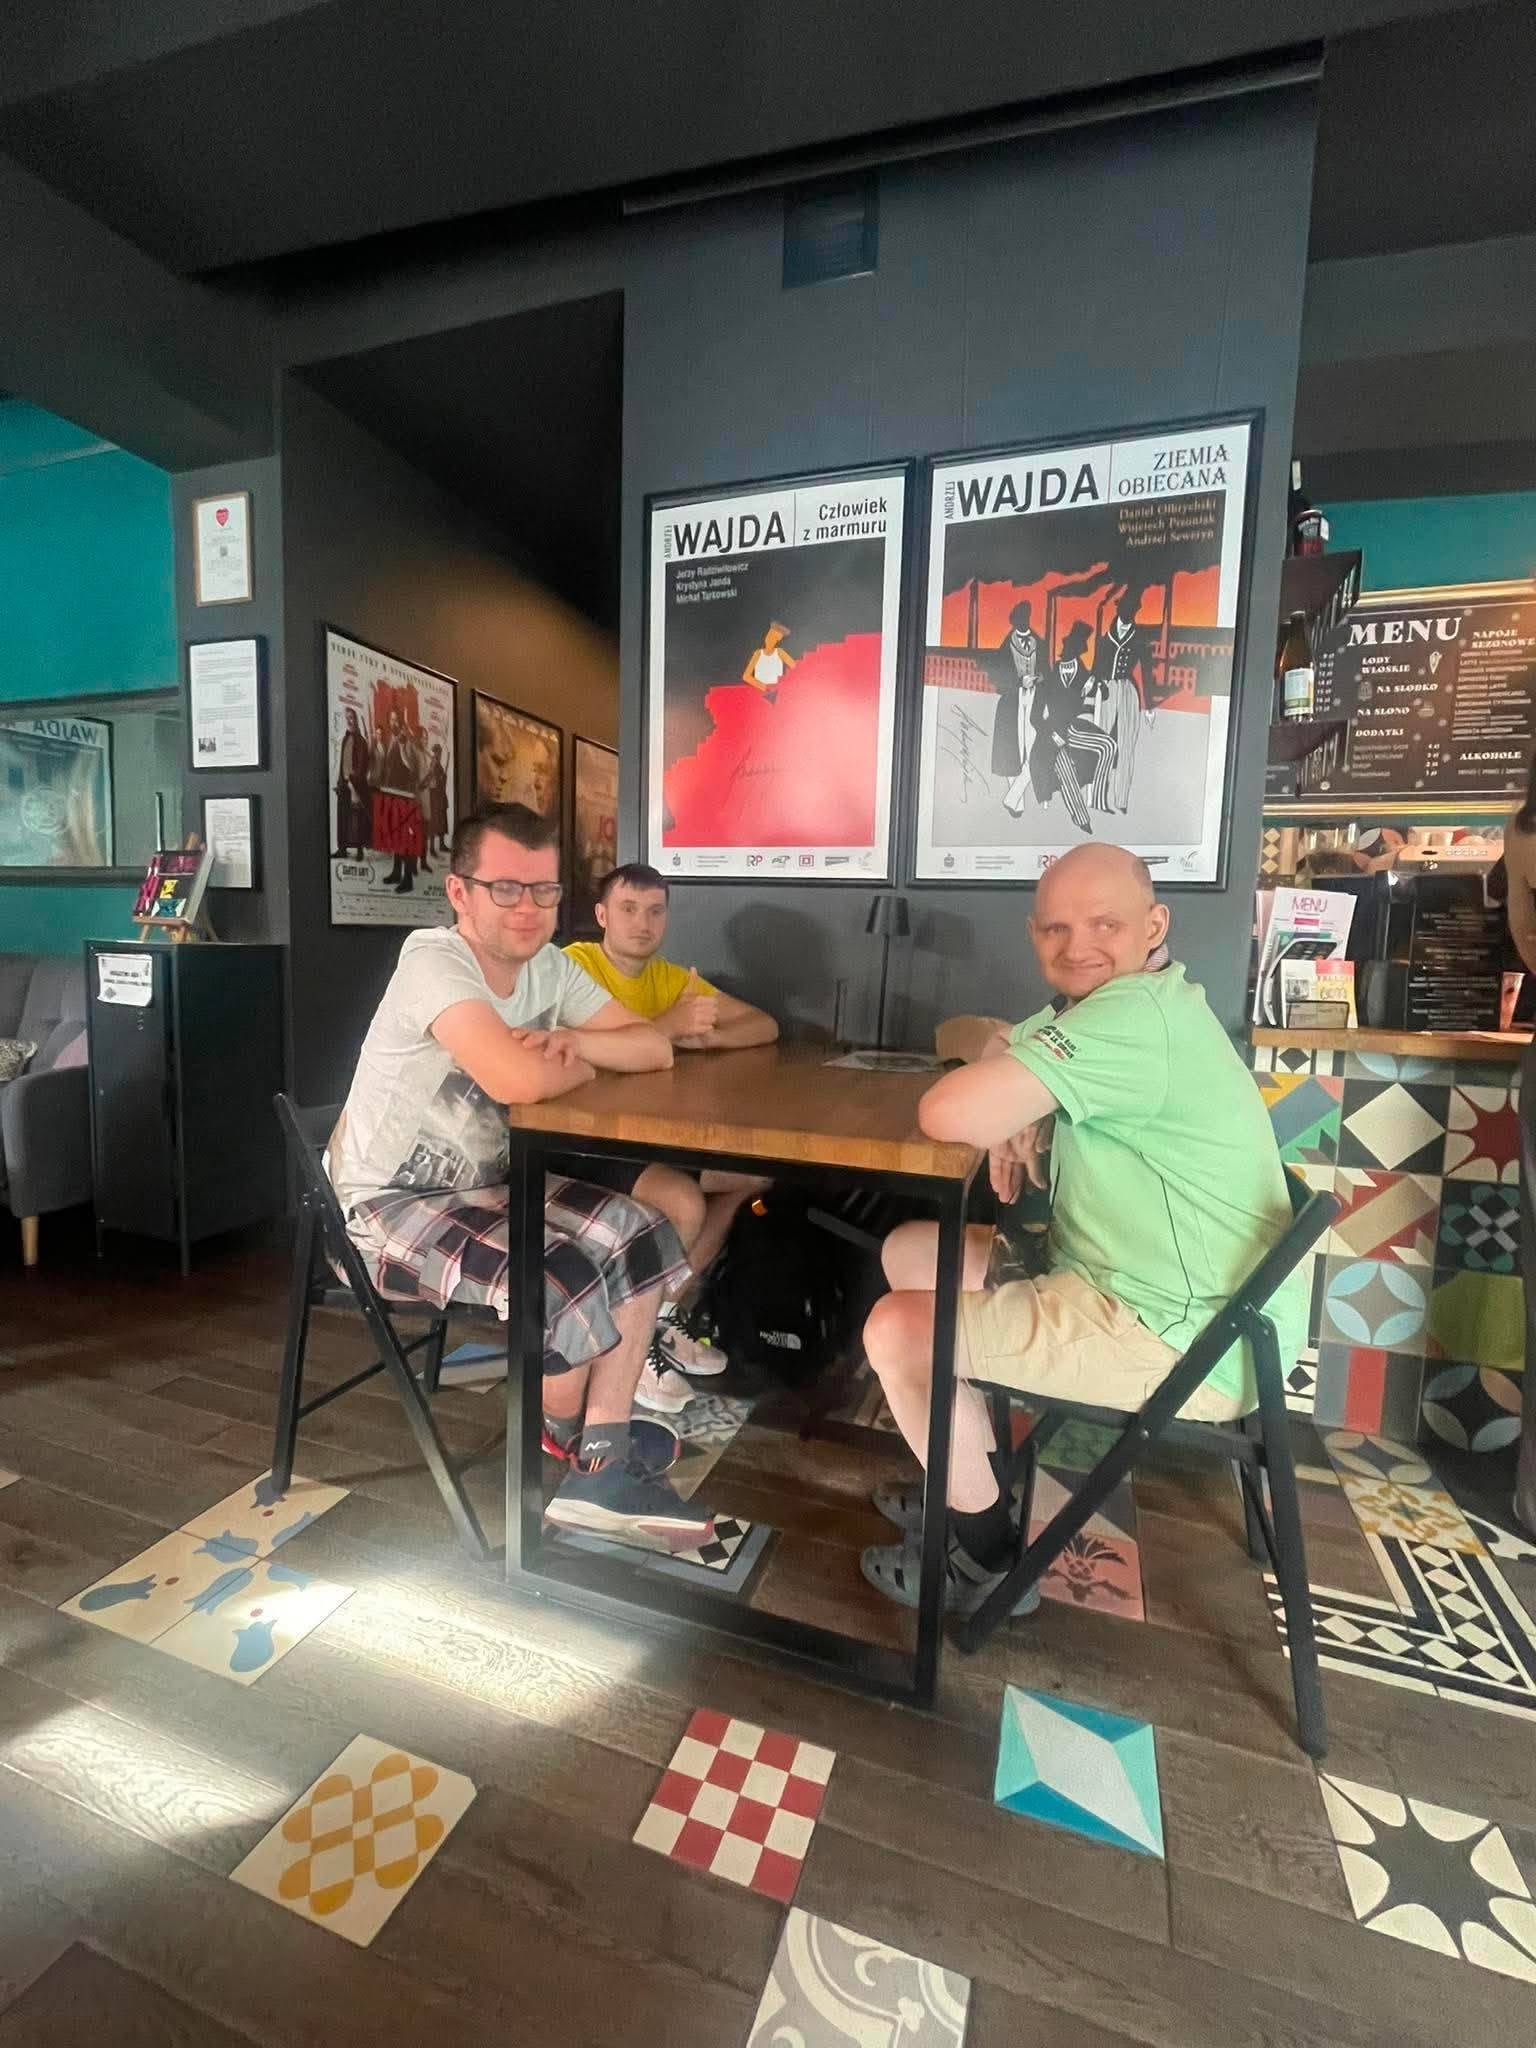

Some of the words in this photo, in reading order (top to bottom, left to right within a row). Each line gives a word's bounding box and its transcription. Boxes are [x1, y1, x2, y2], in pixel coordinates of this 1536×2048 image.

[1153, 444, 1229, 471] ZIEMIA
[957, 463, 1100, 517] WAJDA
[1118, 467, 1227, 496] OBIECANA
[819, 497, 888, 521] Człowiek
[944, 481, 955, 520] ANDRZEJ
[1119, 503, 1154, 520] Daniel
[673, 511, 786, 557] WAJDA
[803, 529, 811, 541] z
[815, 519, 888, 541] marmuru
[1126, 532, 1167, 546] Andrzej
[664, 524, 673, 560] ANDRZEJ
[1346, 617, 1462, 647] MENU
[1473, 629, 1518, 640] NAPOJE
[1376, 685, 1391, 694] NA
[1357, 708, 1371, 716] NA
[1355, 728, 1404, 737] DODATKI
[1459, 751, 1522, 760] ALKOHOLE
[1292, 896, 1328, 913] MENU
